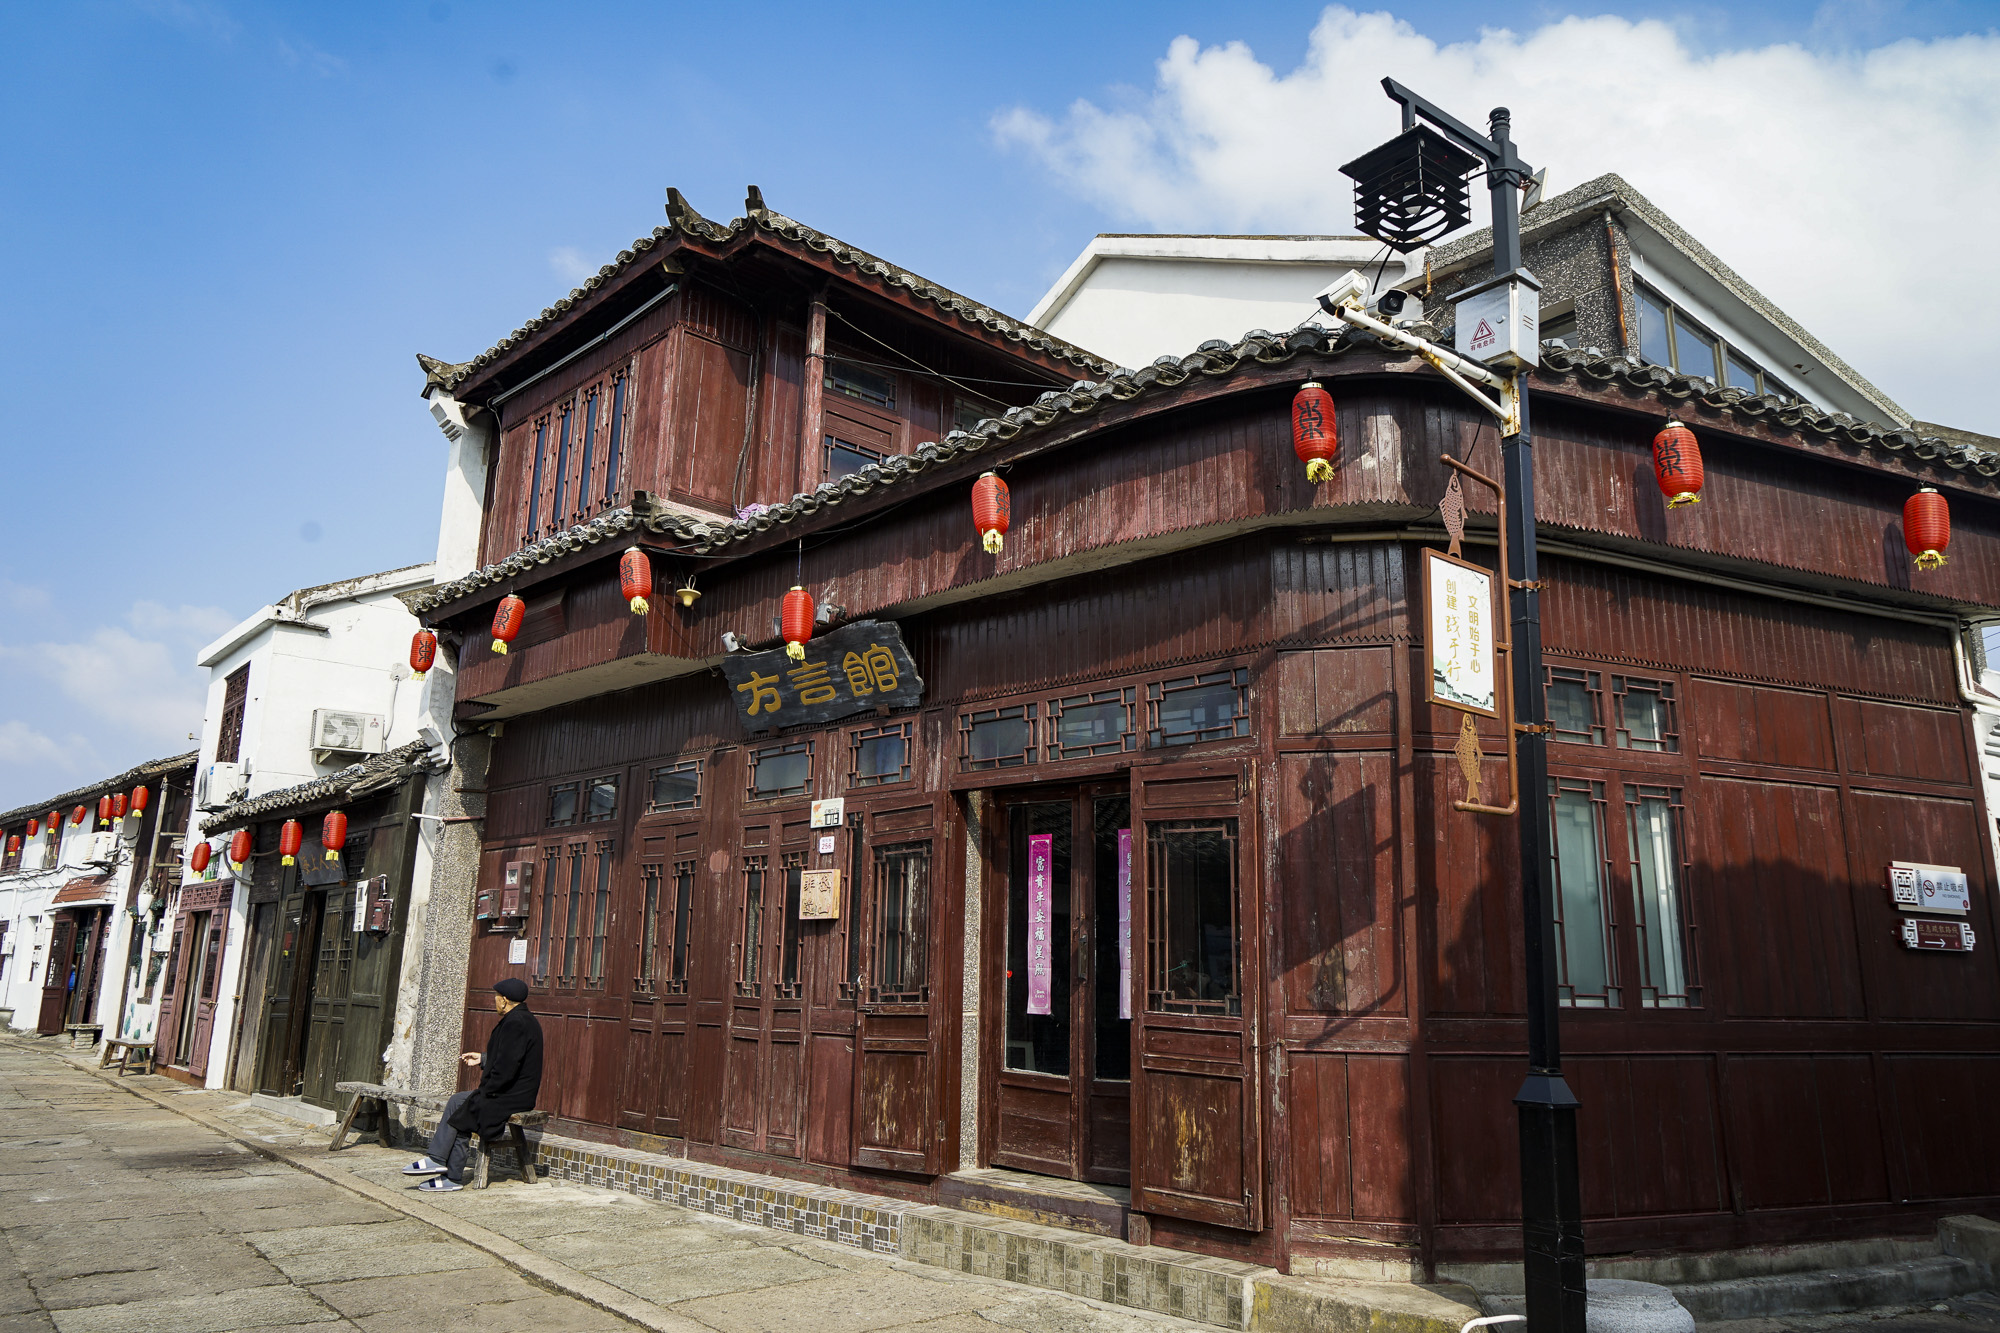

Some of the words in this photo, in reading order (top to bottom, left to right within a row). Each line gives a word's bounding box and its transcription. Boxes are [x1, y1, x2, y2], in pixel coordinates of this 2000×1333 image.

[1445, 578, 1462, 682] 创建践于行
[1467, 595, 1481, 674] 文明始于心
[736, 643, 900, 717] 方言館
